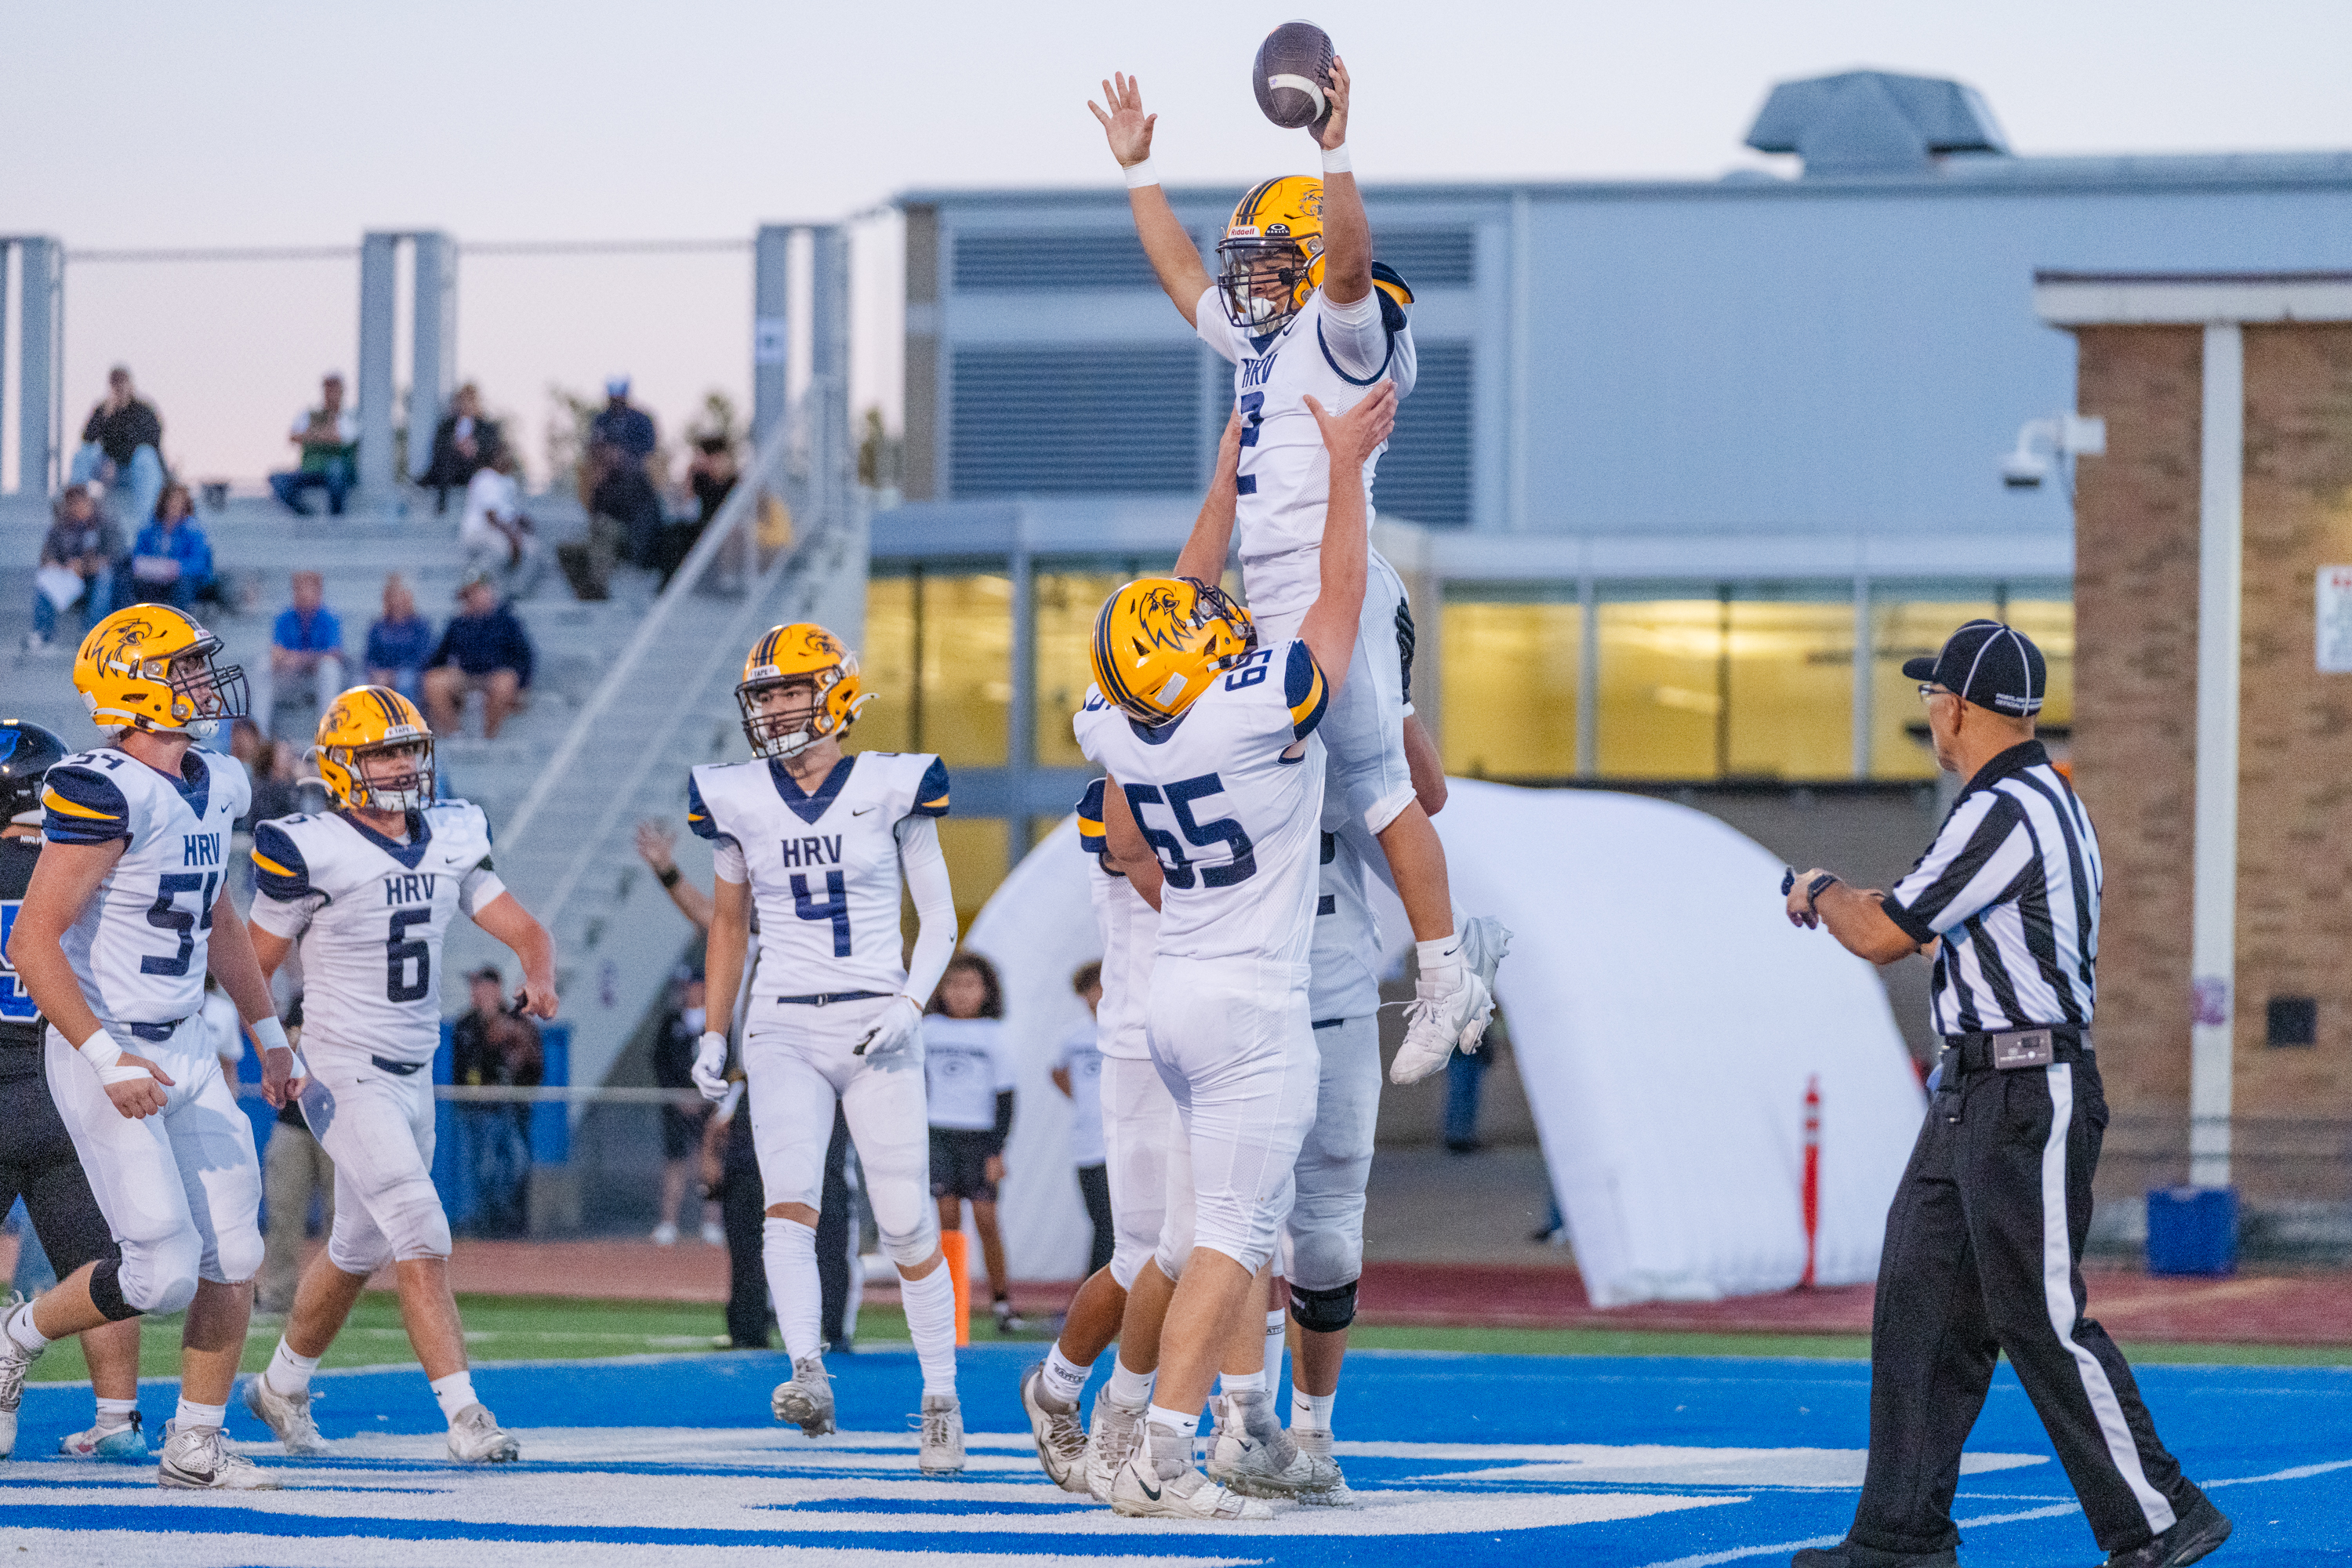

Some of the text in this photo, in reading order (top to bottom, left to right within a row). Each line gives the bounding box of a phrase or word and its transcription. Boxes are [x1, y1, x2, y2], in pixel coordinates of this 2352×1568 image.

[1231, 227, 1255, 236] Riddell
[1241, 353, 1279, 389] HRV
[1123, 771, 1258, 890] 65
[183, 832, 220, 866] HRV
[780, 833, 843, 868] HRV
[383, 873, 436, 906] HRV
[789, 869, 852, 958] 4
[386, 906, 432, 1004] 6
